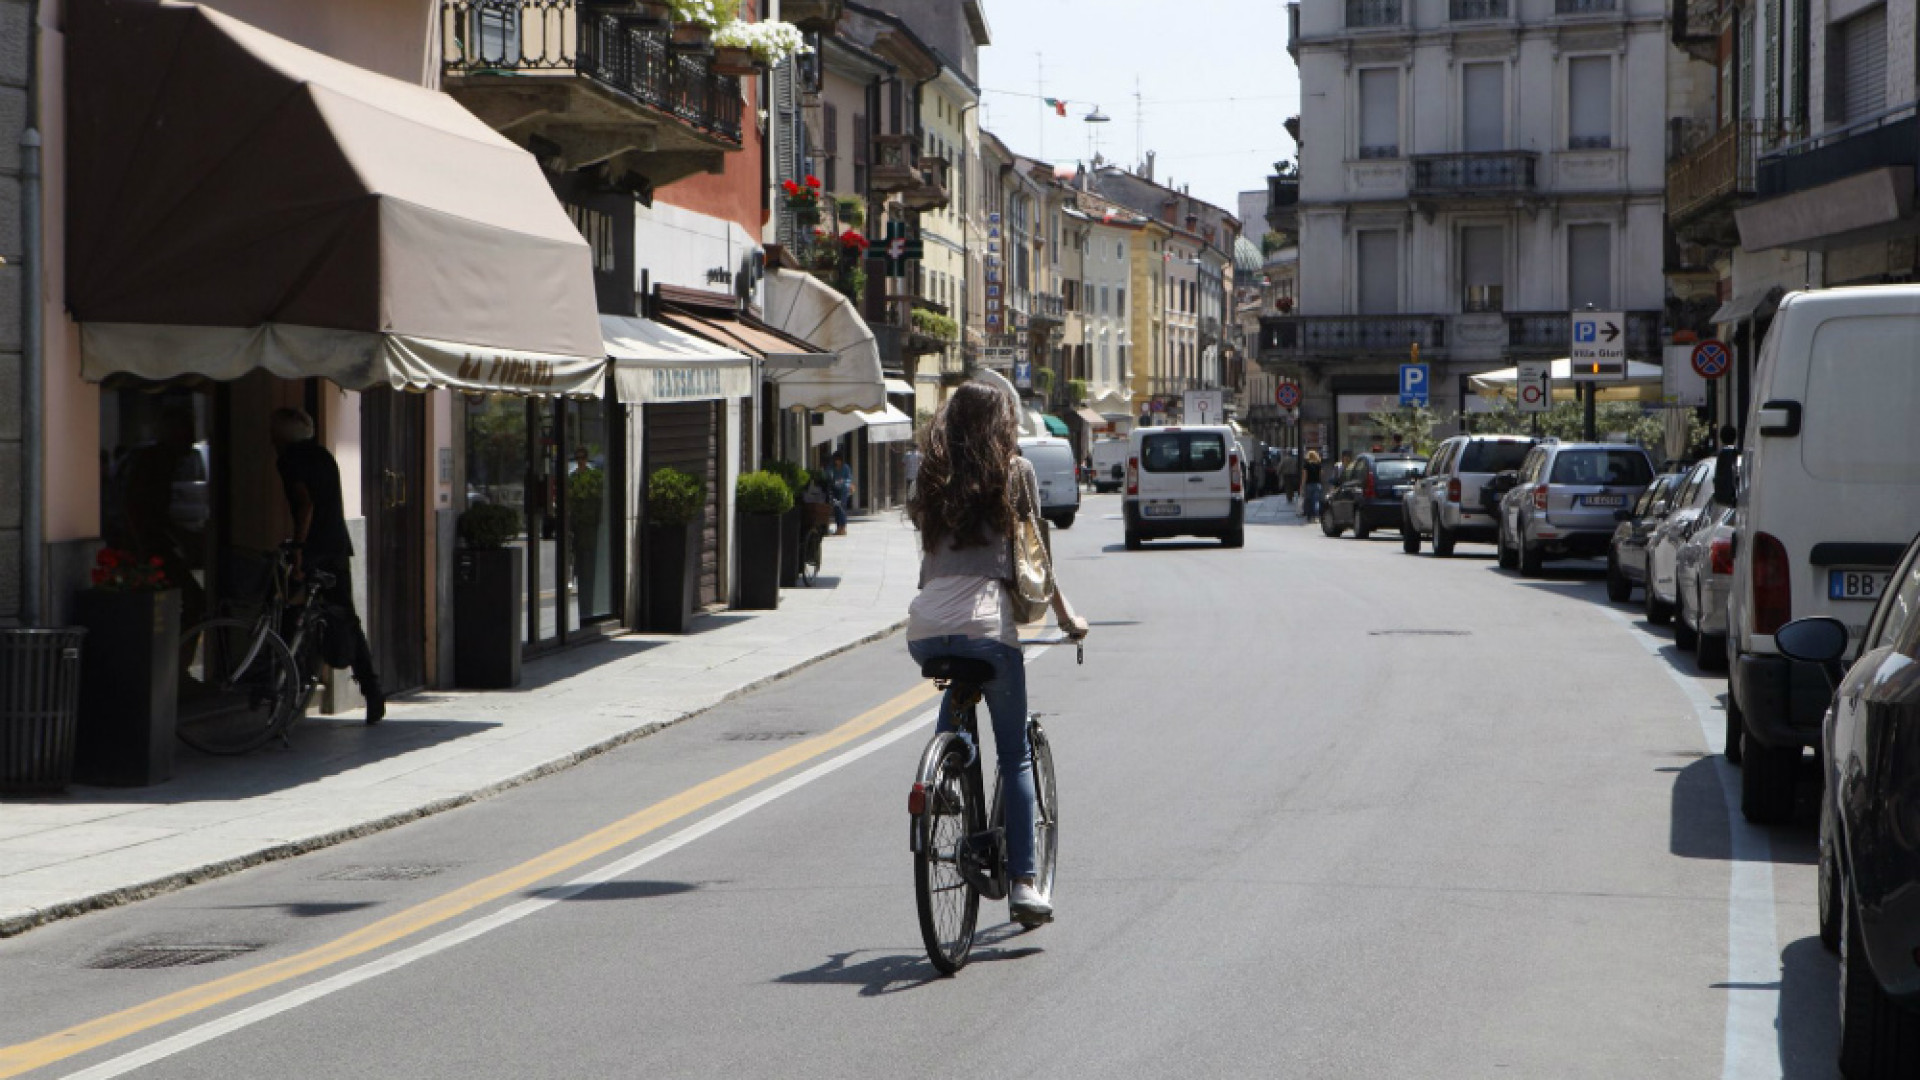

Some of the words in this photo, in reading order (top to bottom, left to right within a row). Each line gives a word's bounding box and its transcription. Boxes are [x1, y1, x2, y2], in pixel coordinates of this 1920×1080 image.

[987, 213, 1000, 323] GALLERIA
[1580, 323, 1593, 341] P
[1405, 367, 1424, 391] P
